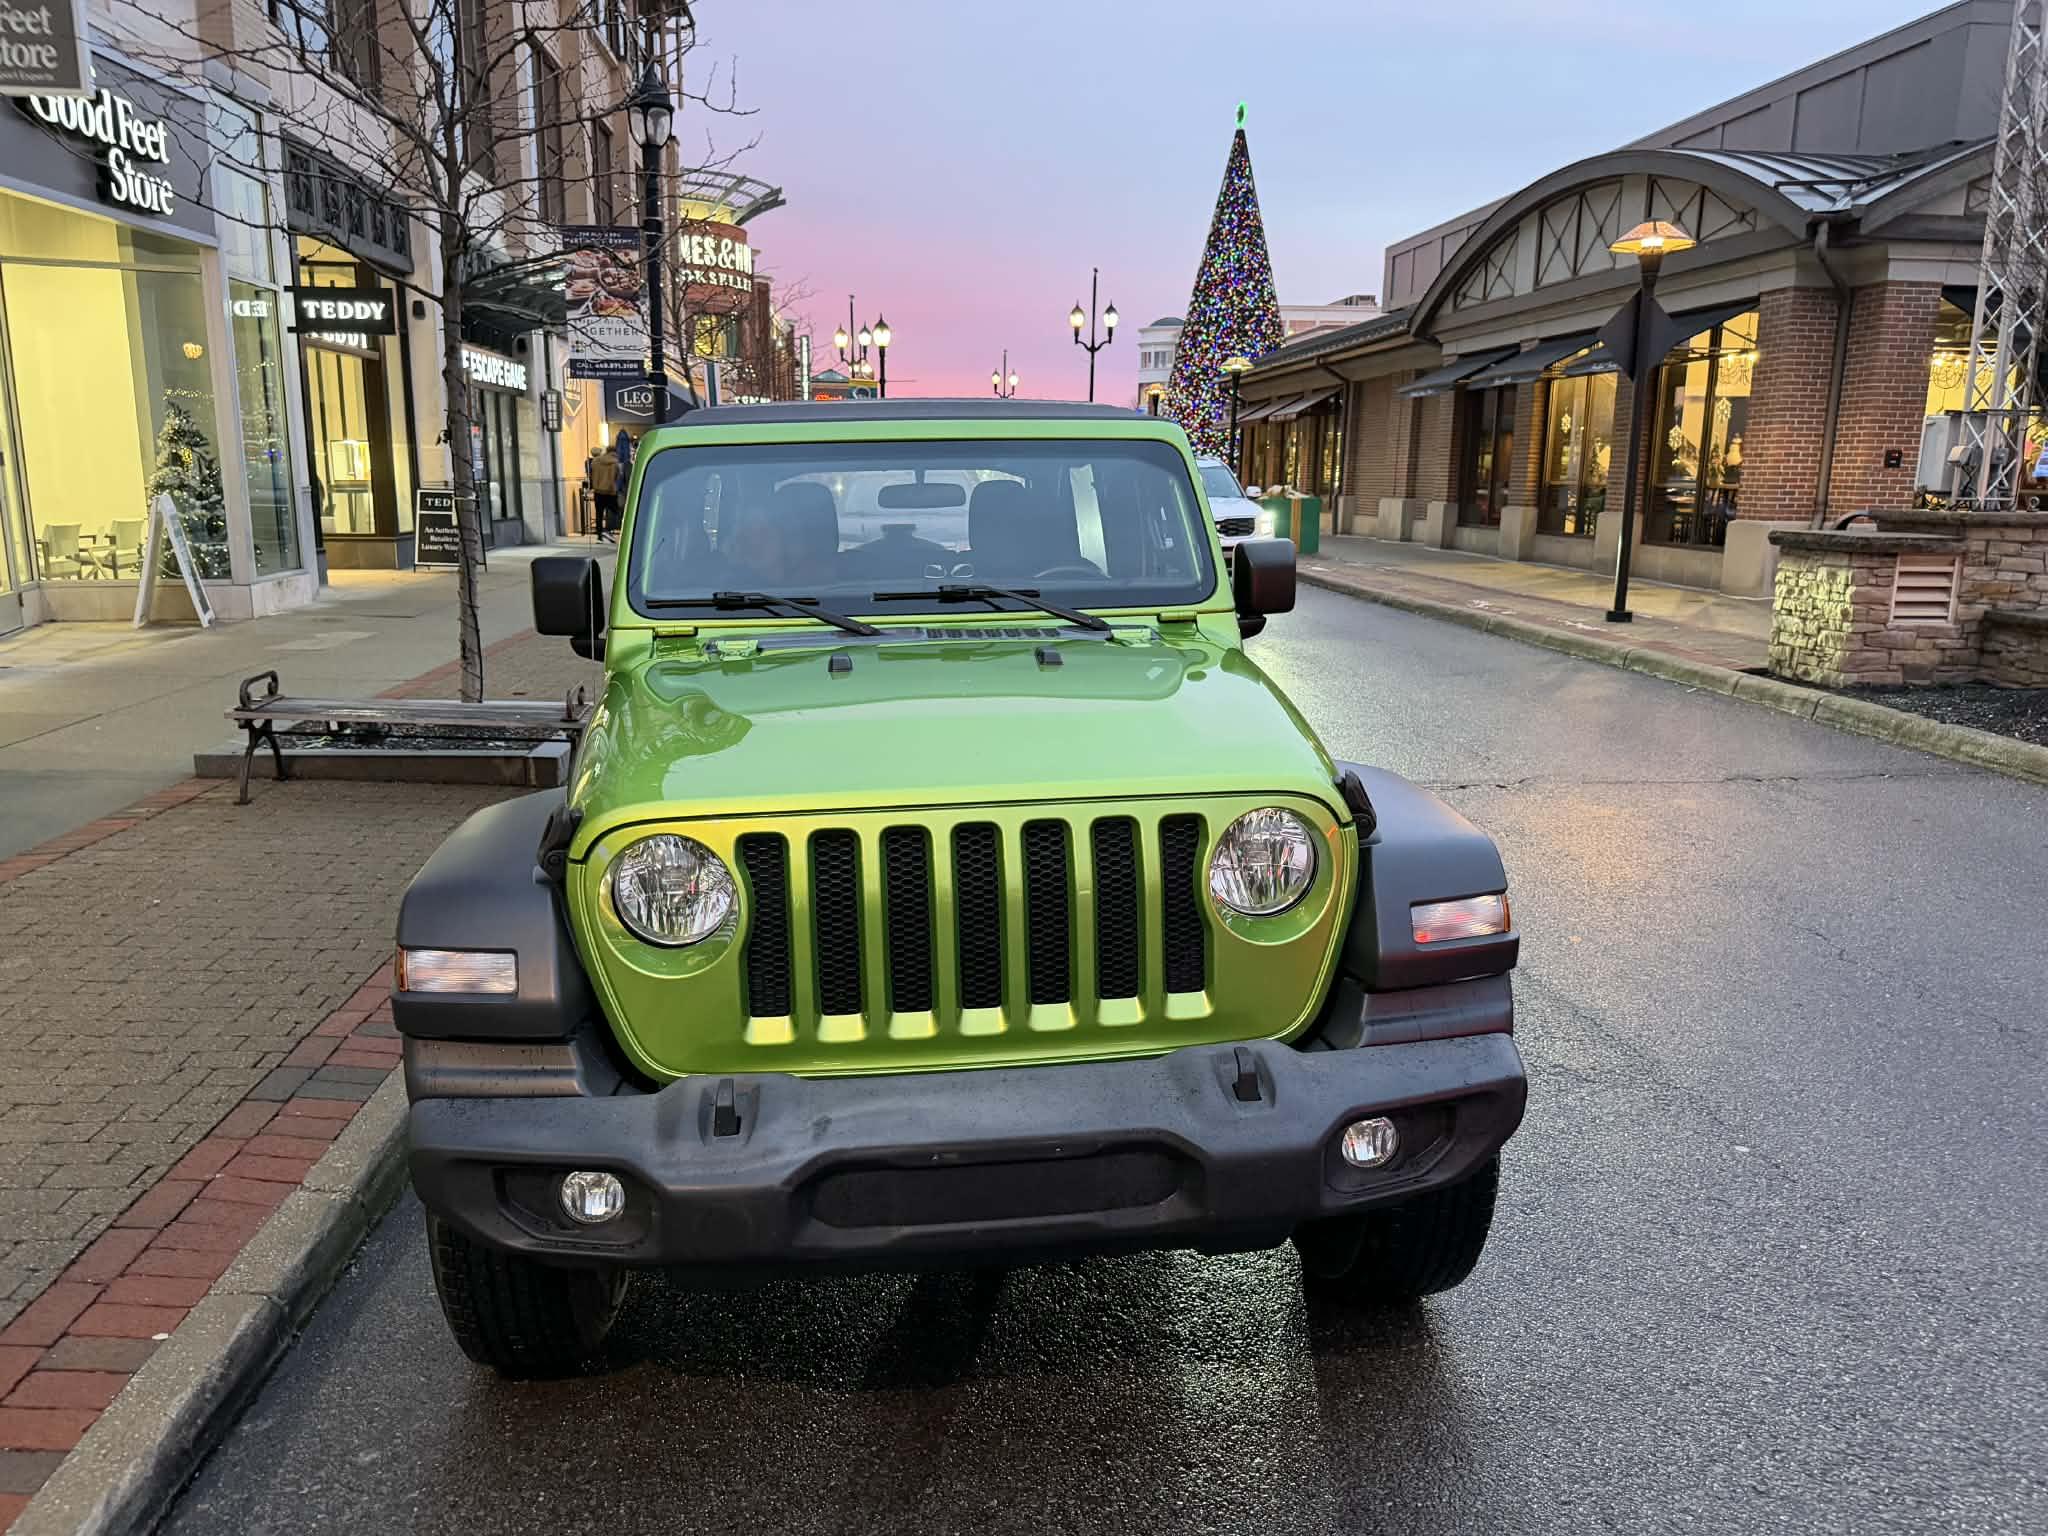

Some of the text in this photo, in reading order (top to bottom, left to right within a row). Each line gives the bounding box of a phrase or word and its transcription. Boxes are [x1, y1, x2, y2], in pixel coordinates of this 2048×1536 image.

[0, 37, 58, 69] tore
[114, 96, 170, 164] Feet
[108, 148, 174, 215] Store
[680, 234, 716, 267] NES
[303, 300, 386, 321] TEDDY
[470, 351, 504, 386] ESCAPE
[504, 360, 527, 391] GAME
[623, 391, 652, 404] LEO
[424, 497, 452, 507] TED
